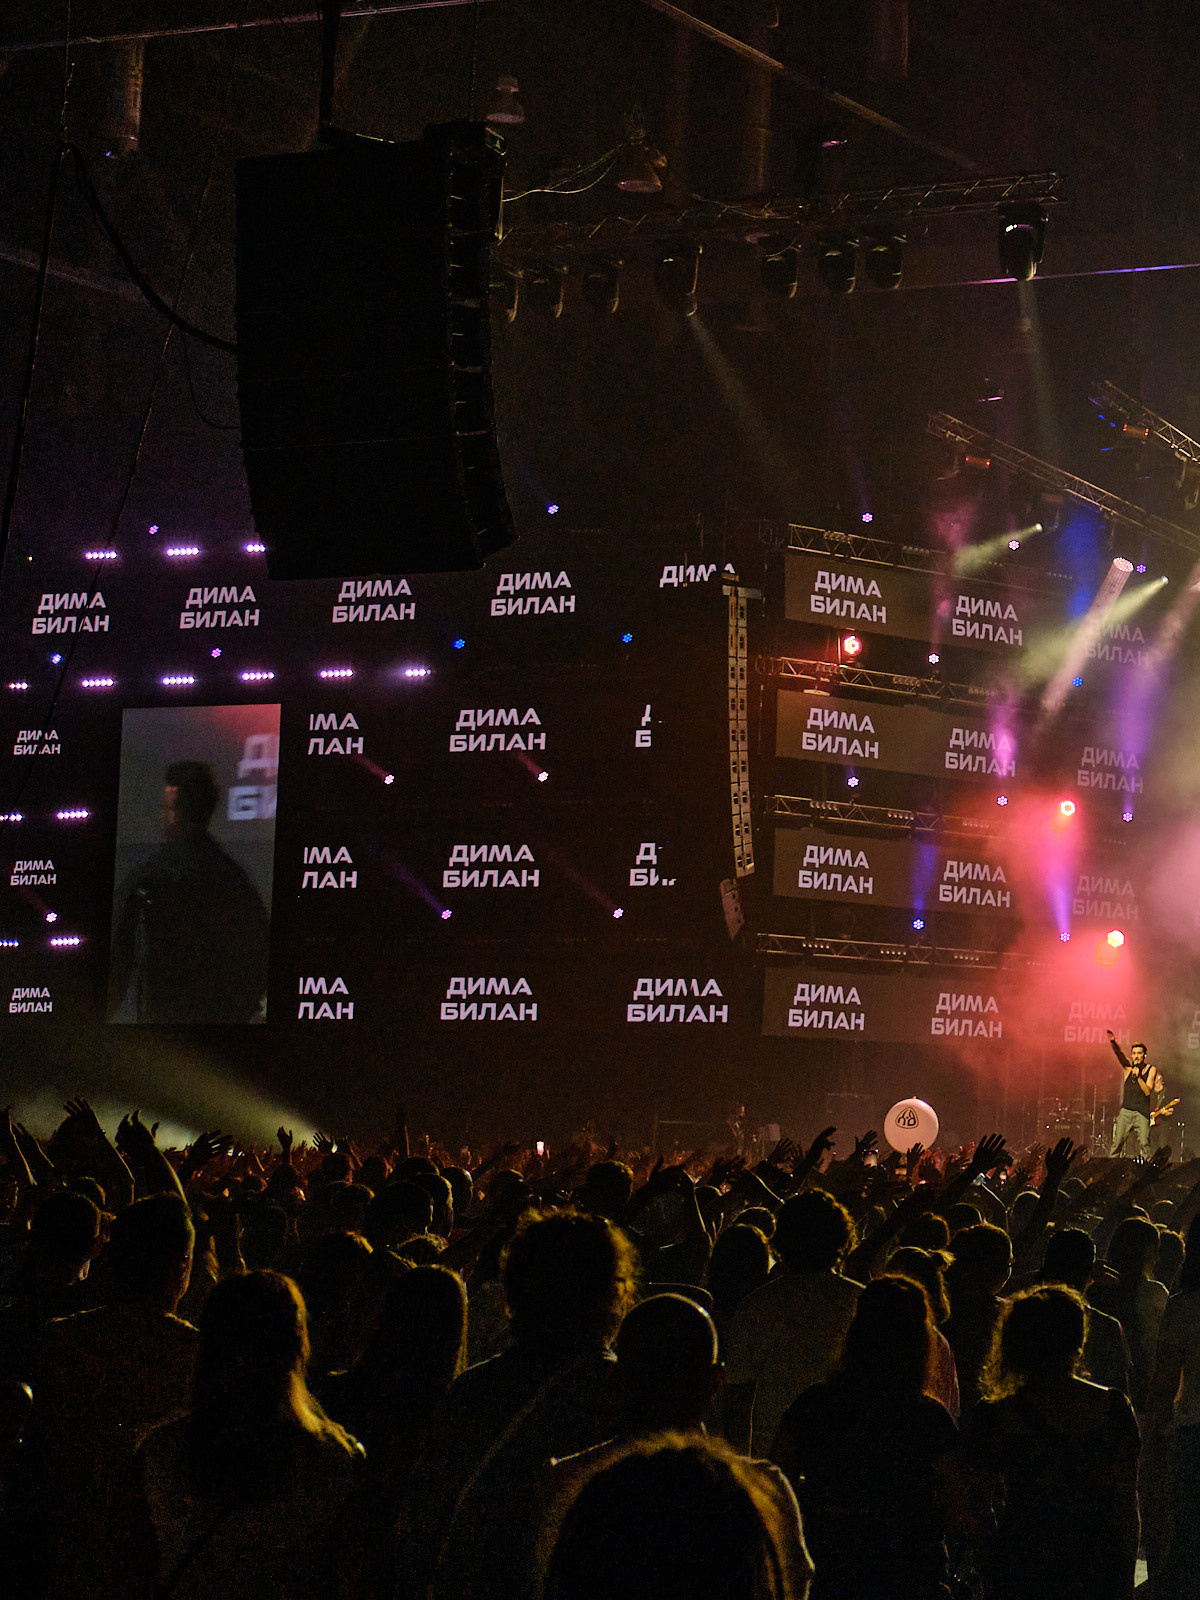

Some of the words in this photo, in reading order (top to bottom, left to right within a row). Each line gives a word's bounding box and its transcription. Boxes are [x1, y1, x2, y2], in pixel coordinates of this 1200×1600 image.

[339, 579, 411, 602] ДИМА
[497, 571, 571, 595] ДИМА
[814, 571, 882, 598] ДИМА
[38, 592, 106, 614] ДИМА
[186, 586, 256, 609] ДИМА
[491, 595, 575, 616] БИЛАН
[956, 595, 1018, 621] ДИМА
[180, 609, 259, 629] БИЛАН
[332, 603, 415, 623] БИЛАН
[810, 594, 887, 624] БИЛАН
[32, 615, 109, 634] БИЛАН
[952, 618, 1022, 646] БИЛАН
[456, 708, 541, 731] ДИМА
[806, 707, 875, 733] ДИМА
[450, 732, 546, 752] БИЛАН
[802, 732, 879, 759] БИЛАН
[950, 728, 1012, 752] ДИМА
[945, 752, 1016, 777] БИЛАН
[1081, 747, 1140, 769] ДИМА
[1077, 770, 1143, 793] БИЛАН
[449, 845, 534, 866] ДИМА
[803, 845, 869, 869] ДИМА
[14, 860, 54, 873] ДИМА
[943, 860, 1006, 883] ДИМА
[11, 874, 56, 885] БИЛАН
[443, 870, 540, 887] БИЛАН
[798, 870, 873, 894] БИЛАН
[1077, 875, 1134, 897] ДИМА
[939, 885, 1010, 908] БИЛАН
[1073, 899, 1139, 920] БИЛАН
[12, 988, 50, 1000] ДИМА
[447, 978, 532, 999] ДИМА
[633, 979, 722, 1000] ДИМА
[793, 983, 861, 1006] ДИМА
[9, 1002, 52, 1013] БИЛАН
[441, 1003, 537, 1021] БИЛАН
[627, 1004, 728, 1023] БИЛАН
[936, 993, 999, 1014] ДИМА
[1069, 1002, 1126, 1023] ДИМА
[788, 1009, 865, 1030] БИЛАН
[931, 1017, 1002, 1038] БИЛАН
[1065, 1025, 1131, 1046] БИЛН
